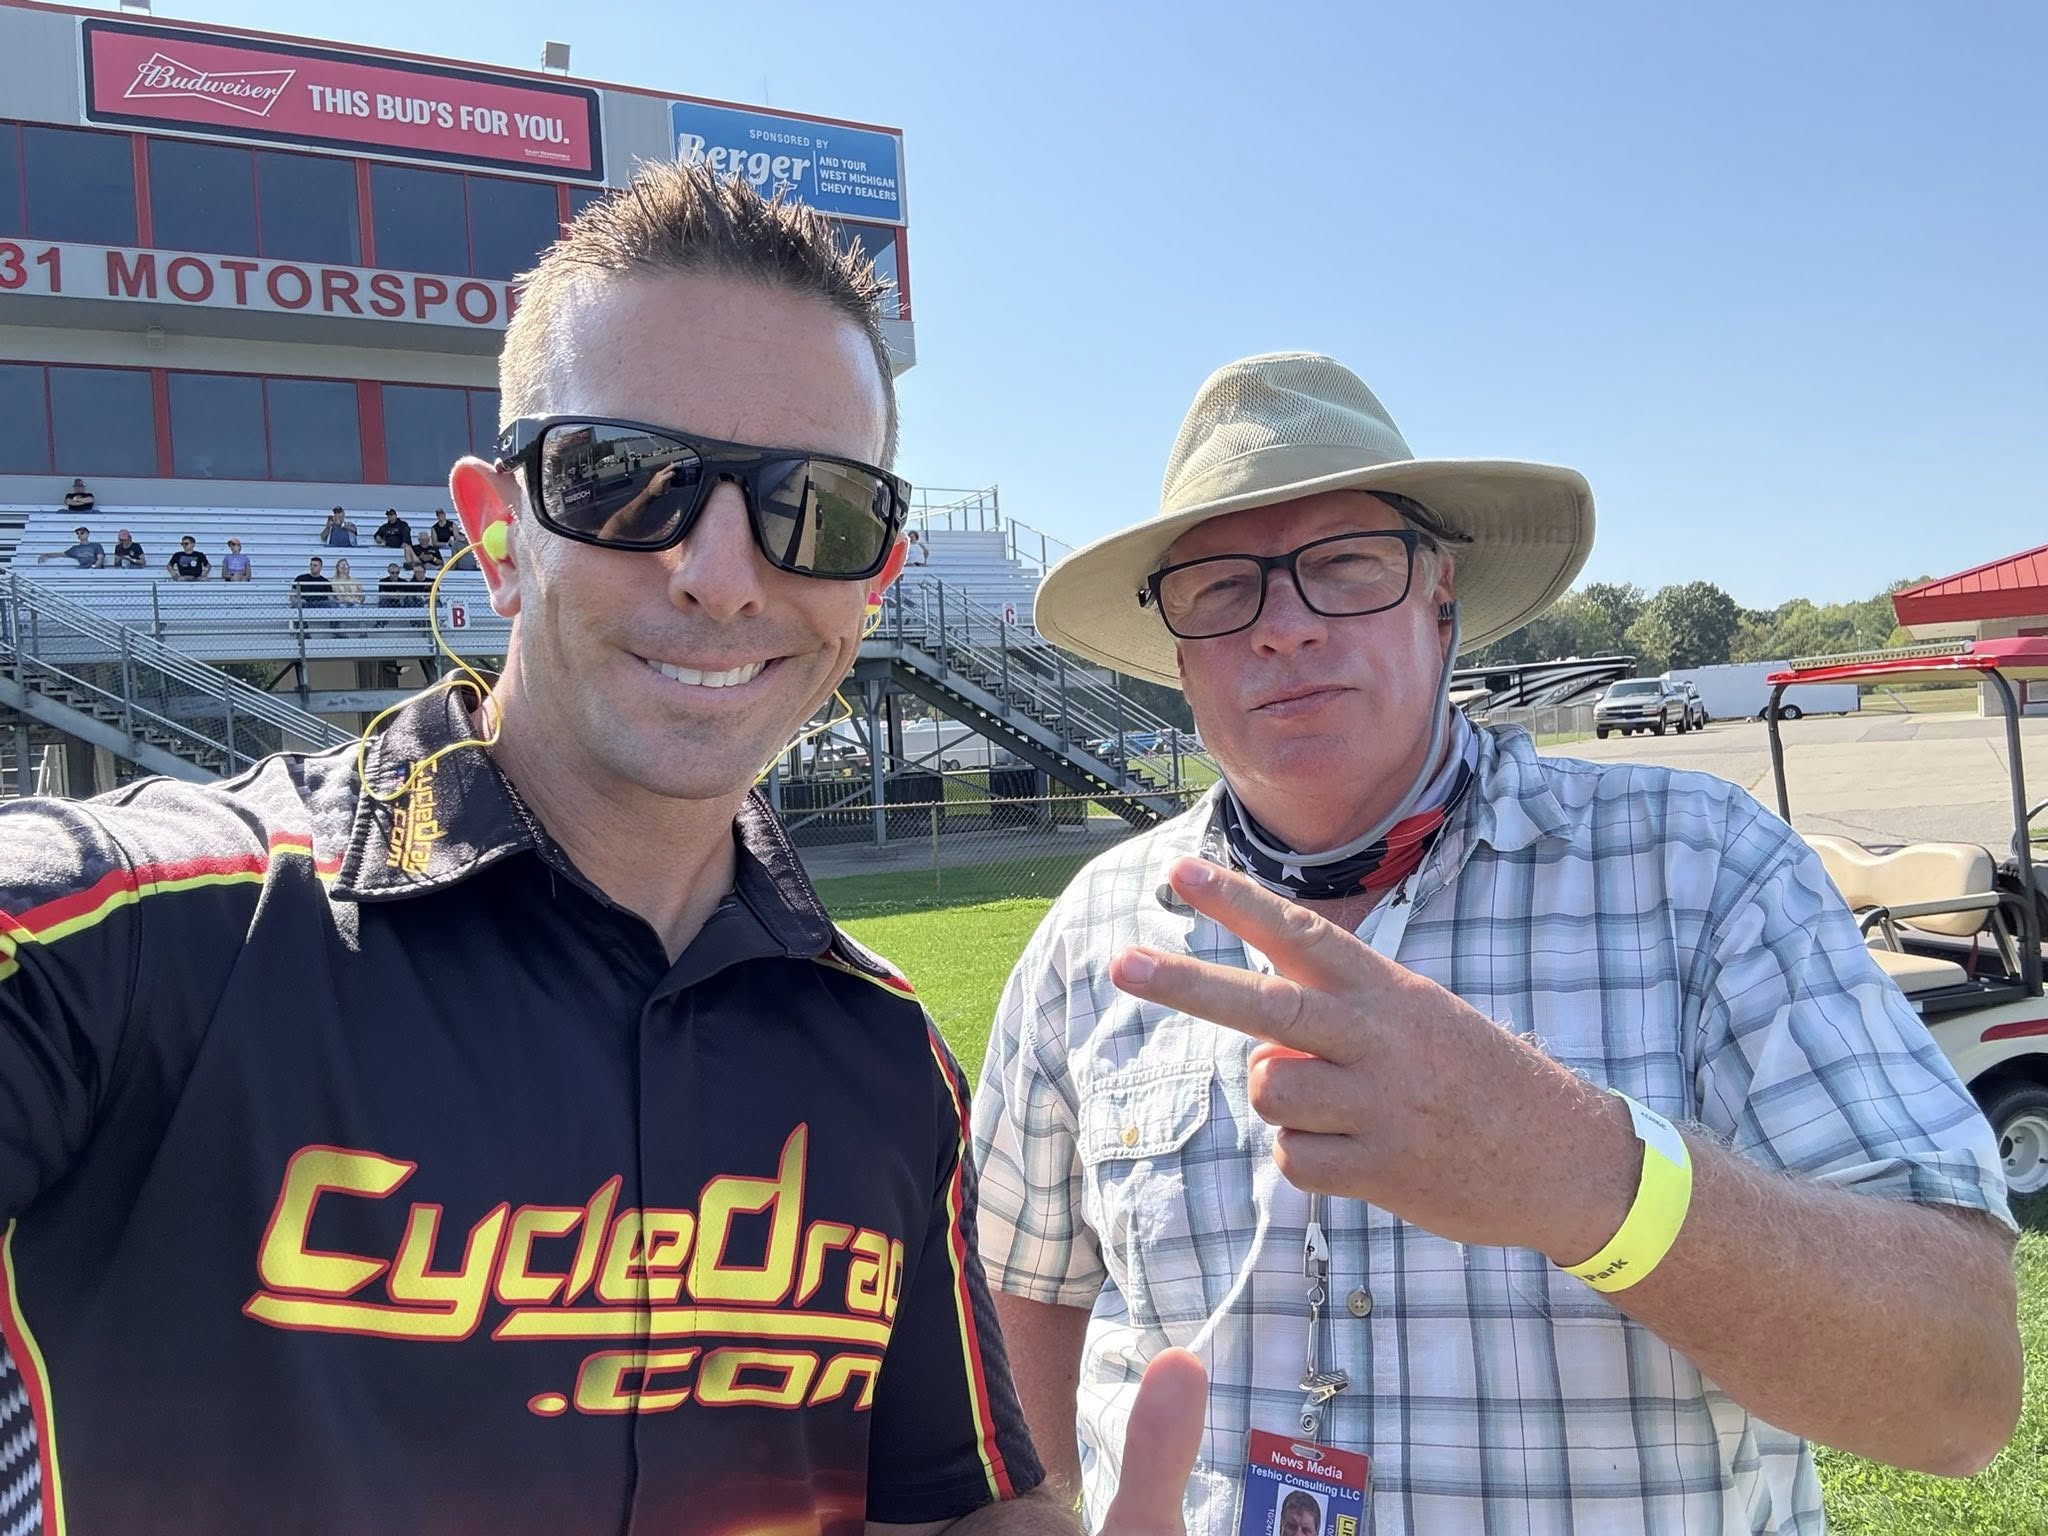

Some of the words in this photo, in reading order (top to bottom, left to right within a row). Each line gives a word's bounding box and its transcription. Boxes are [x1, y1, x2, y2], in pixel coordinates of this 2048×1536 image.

[138, 62, 279, 100] Budweiser
[308, 84, 370, 118] THIS
[376, 93, 454, 129] BUD'S
[460, 105, 509, 136] FOR
[514, 112, 570, 145] YOU.
[749, 129, 810, 147] SPONSORED
[816, 139, 829, 149] BY
[679, 132, 811, 185] Berger
[819, 156, 839, 168] AND
[841, 158, 866, 172] YOUR
[820, 169, 847, 182] WEST
[849, 173, 895, 189] MICHIGAN
[821, 182, 851, 195] CHEVY
[855, 186, 897, 202] DEALERS
[106, 251, 520, 325] MOTORSPO
[452, 607, 466, 628] B
[1005, 608, 1015, 625] C
[1582, 1258, 1629, 1282] Park
[1271, 1451, 1304, 1470] News
[1306, 1459, 1343, 1480] Media
[1251, 1464, 1283, 1481] Teshio
[1285, 1474, 1338, 1497] Consulting
[1340, 1488, 1361, 1501] LLC
